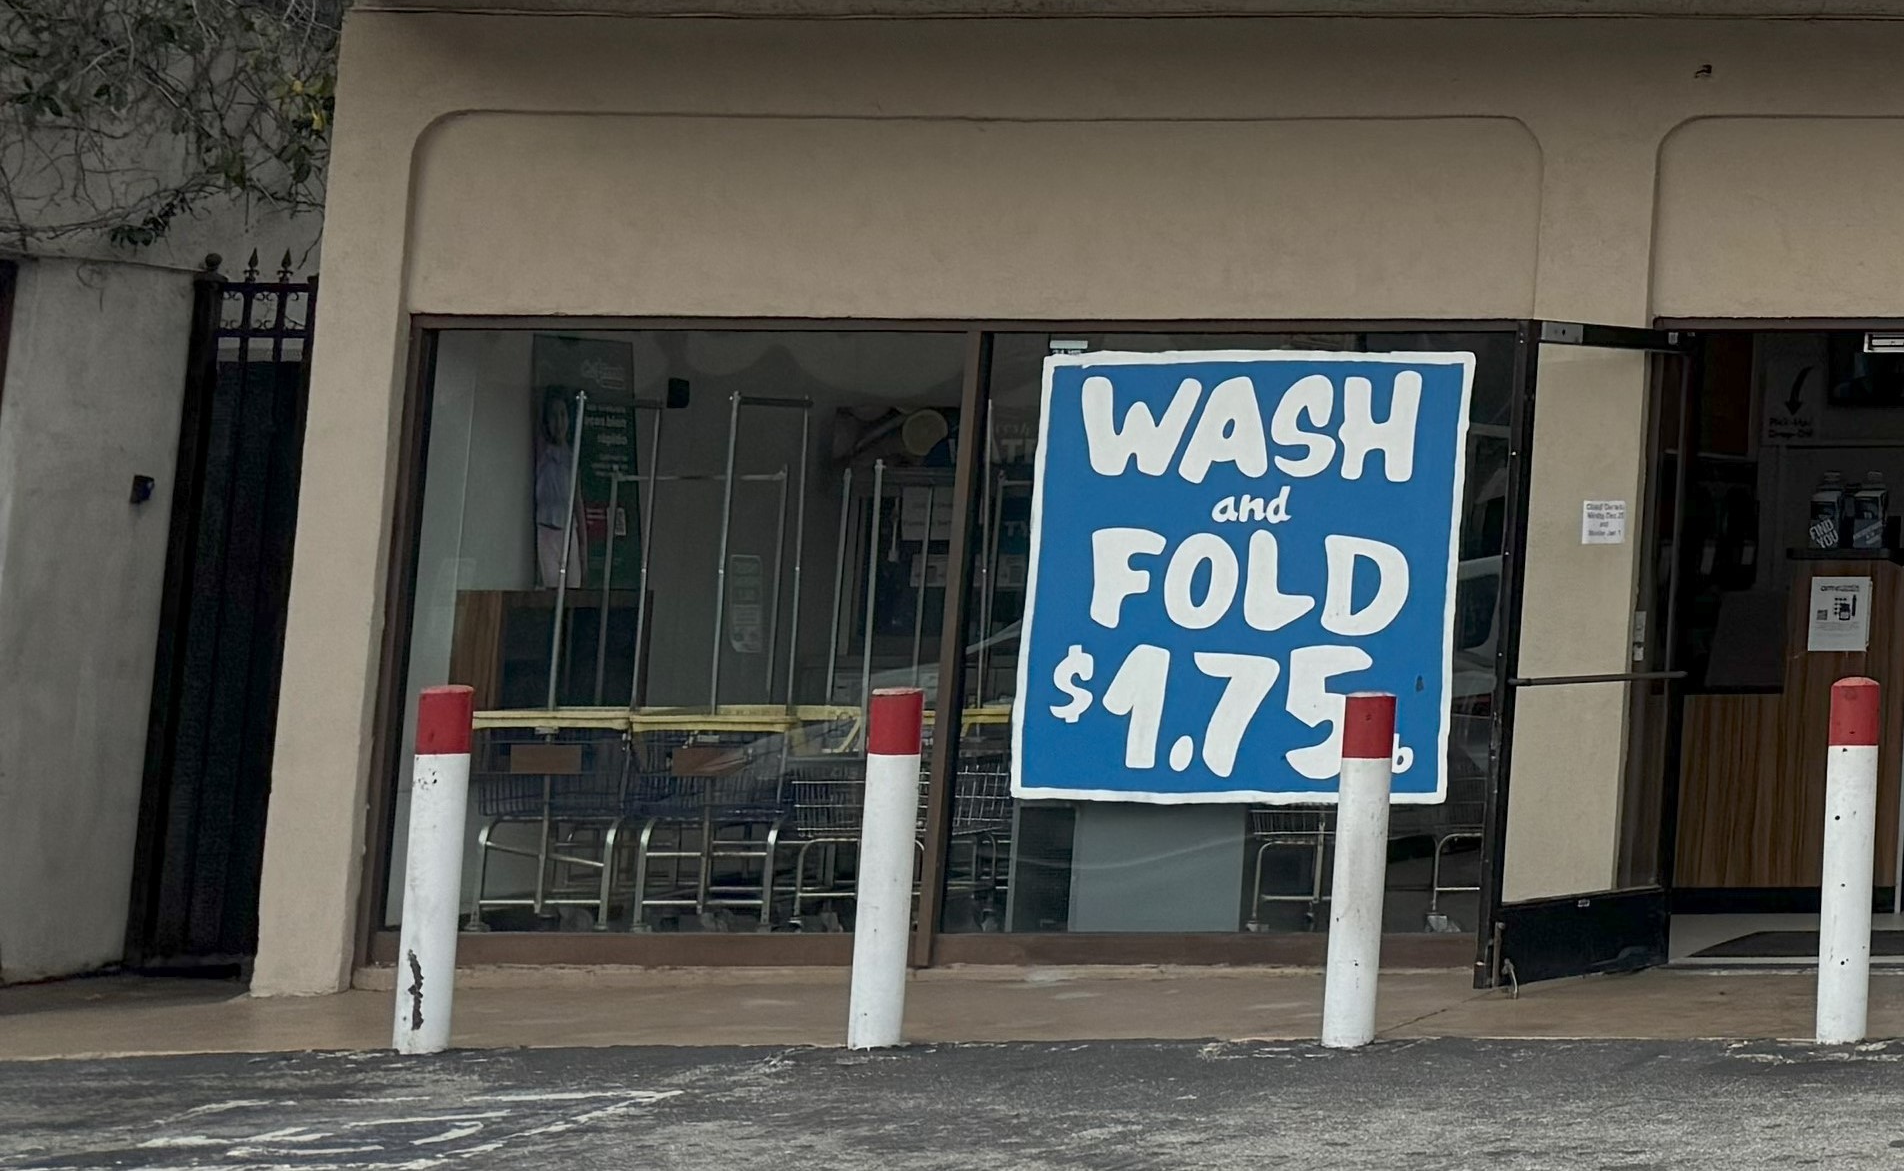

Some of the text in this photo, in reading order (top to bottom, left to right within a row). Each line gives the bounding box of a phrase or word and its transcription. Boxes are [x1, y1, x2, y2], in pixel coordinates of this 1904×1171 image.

[1082, 371, 1422, 483] WASH
[1211, 486, 1291, 523] and
[1809, 518, 1834, 541] FIND
[1816, 530, 1839, 548] YOU
[1090, 529, 1410, 636] FOLD
[1049, 644, 1414, 780] $1.75 b
